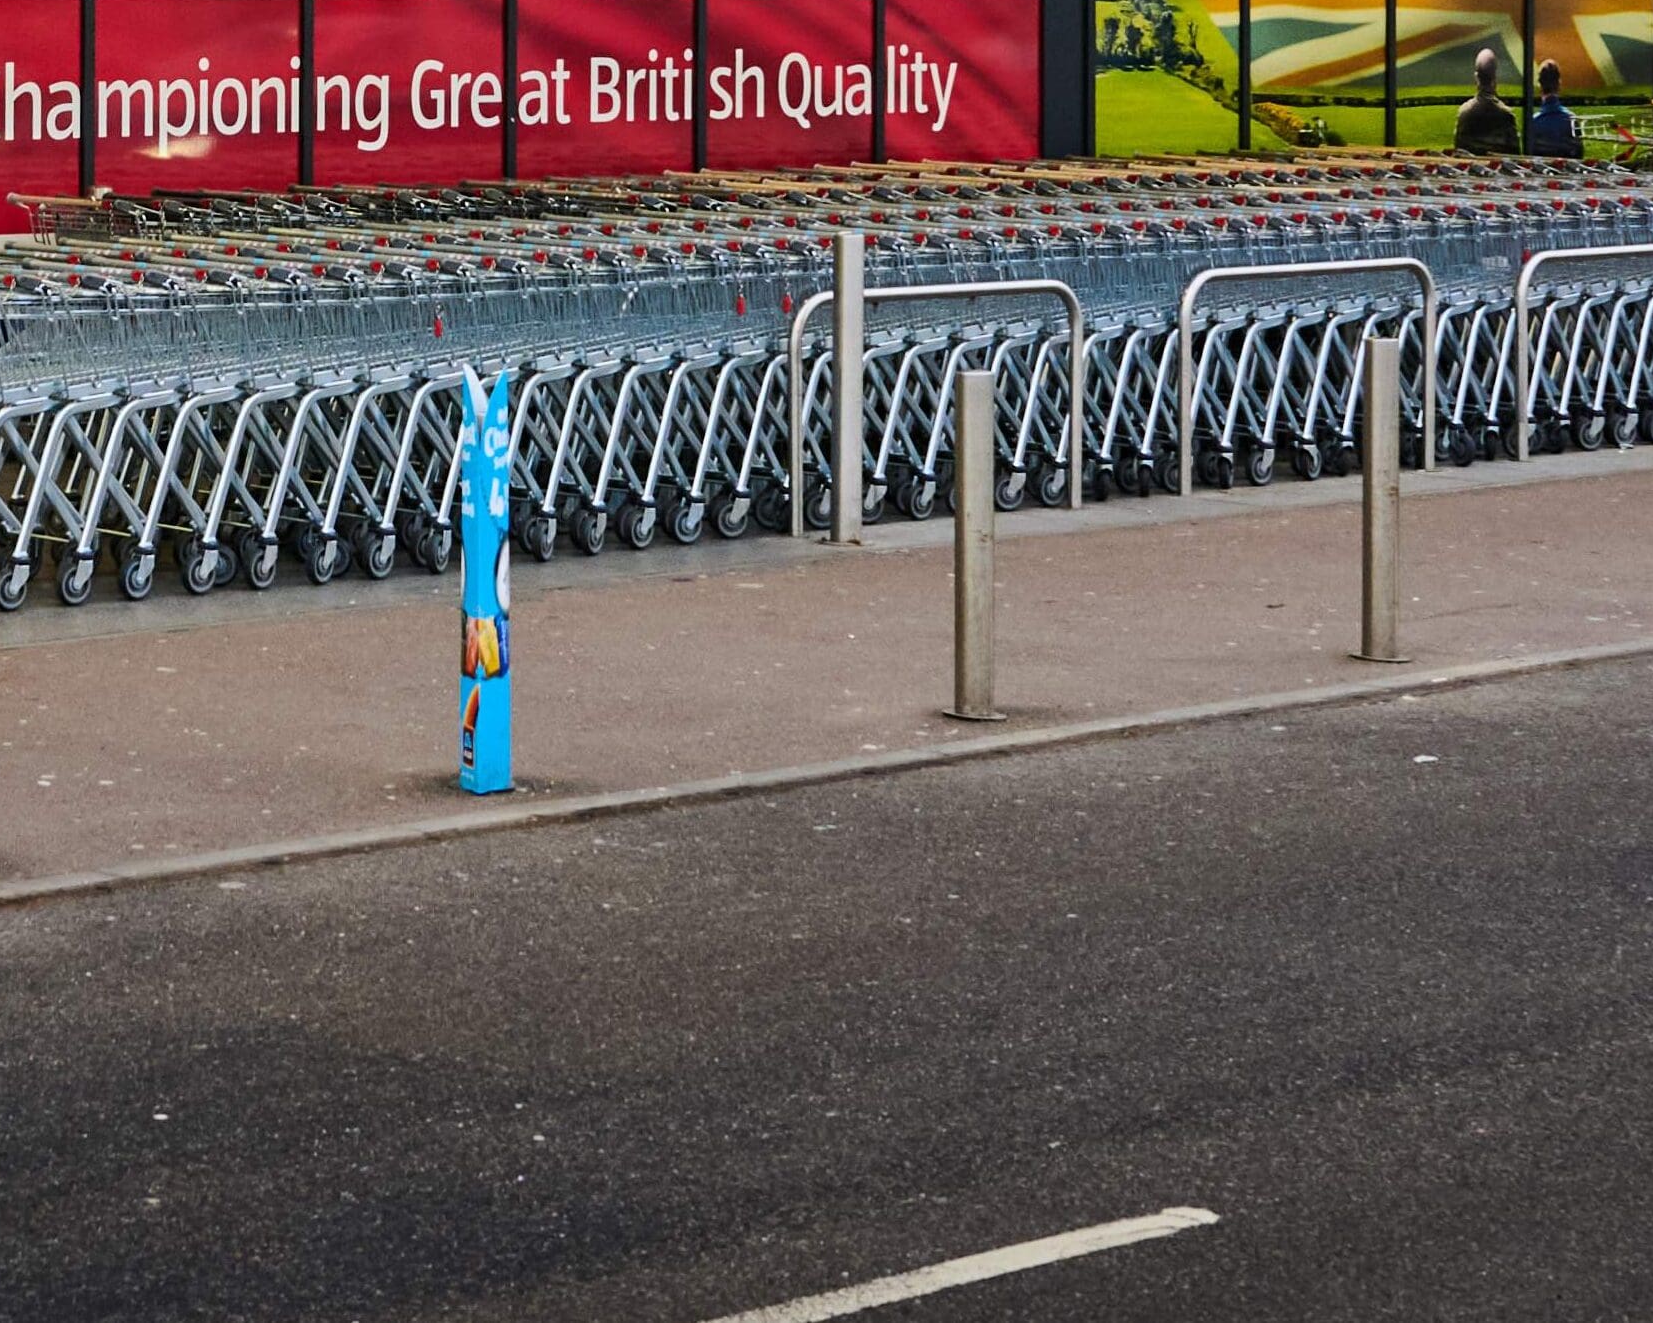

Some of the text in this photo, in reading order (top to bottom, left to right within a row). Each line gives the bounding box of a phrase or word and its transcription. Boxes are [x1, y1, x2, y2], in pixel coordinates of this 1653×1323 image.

[410, 57, 572, 130] Great
[590, 48, 765, 123] British
[778, 44, 958, 131] Quality
